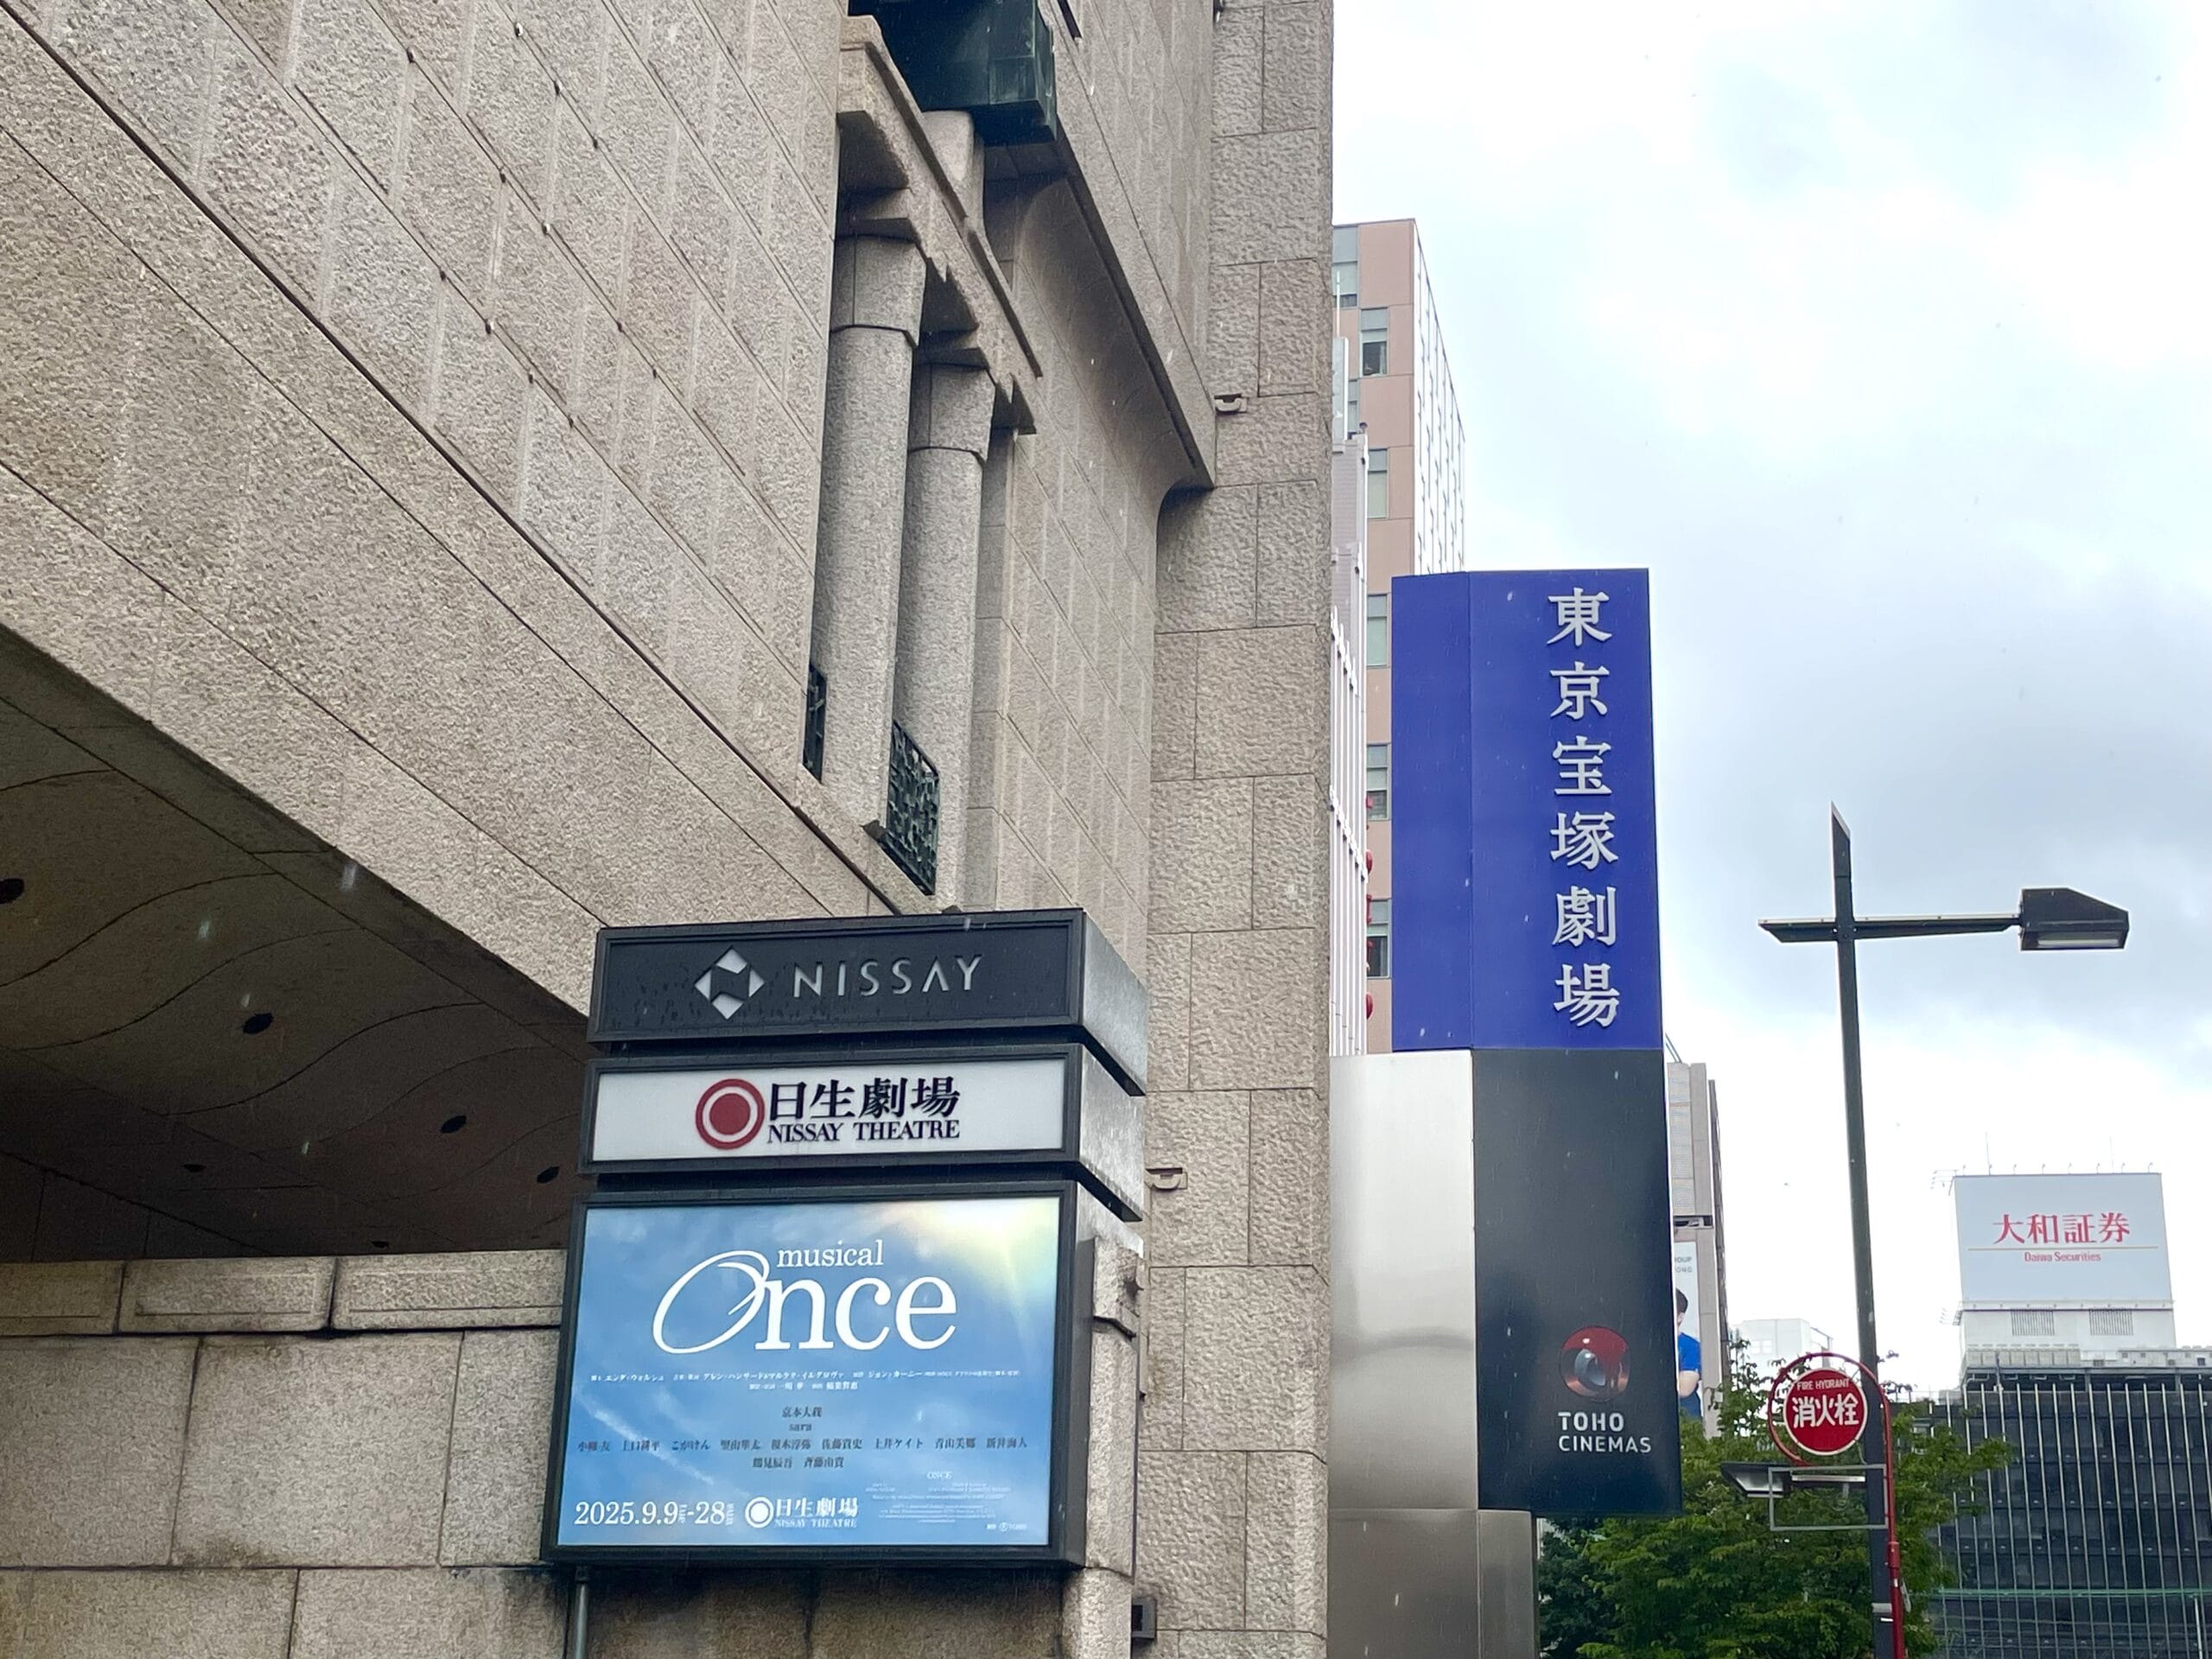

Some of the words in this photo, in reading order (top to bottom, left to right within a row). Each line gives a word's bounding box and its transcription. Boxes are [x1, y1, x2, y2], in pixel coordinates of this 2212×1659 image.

[1548, 588, 1620, 1027] 東京宝塚劇場
[793, 954, 983, 998] NISSAY
[769, 1076, 961, 1121] 日生劇場
[767, 1122, 842, 1144] NISSAY
[855, 1119, 960, 1141] THEATRE
[1993, 1212, 2130, 1244] 大和証券
[777, 1239, 883, 1268] musical
[2024, 1252, 2052, 1262] Daiwa
[2055, 1251, 2101, 1262] Securities
[652, 1249, 957, 1355] Once
[1797, 1381, 1813, 1390] FIRE
[1815, 1378, 1849, 1389] HYDRANT
[1558, 1411, 1624, 1432] TOHO
[1792, 1393, 1859, 1428] 消火栓
[1559, 1435, 1651, 1453] CINEMAS
[776, 1497, 858, 1517] 日生劇場
